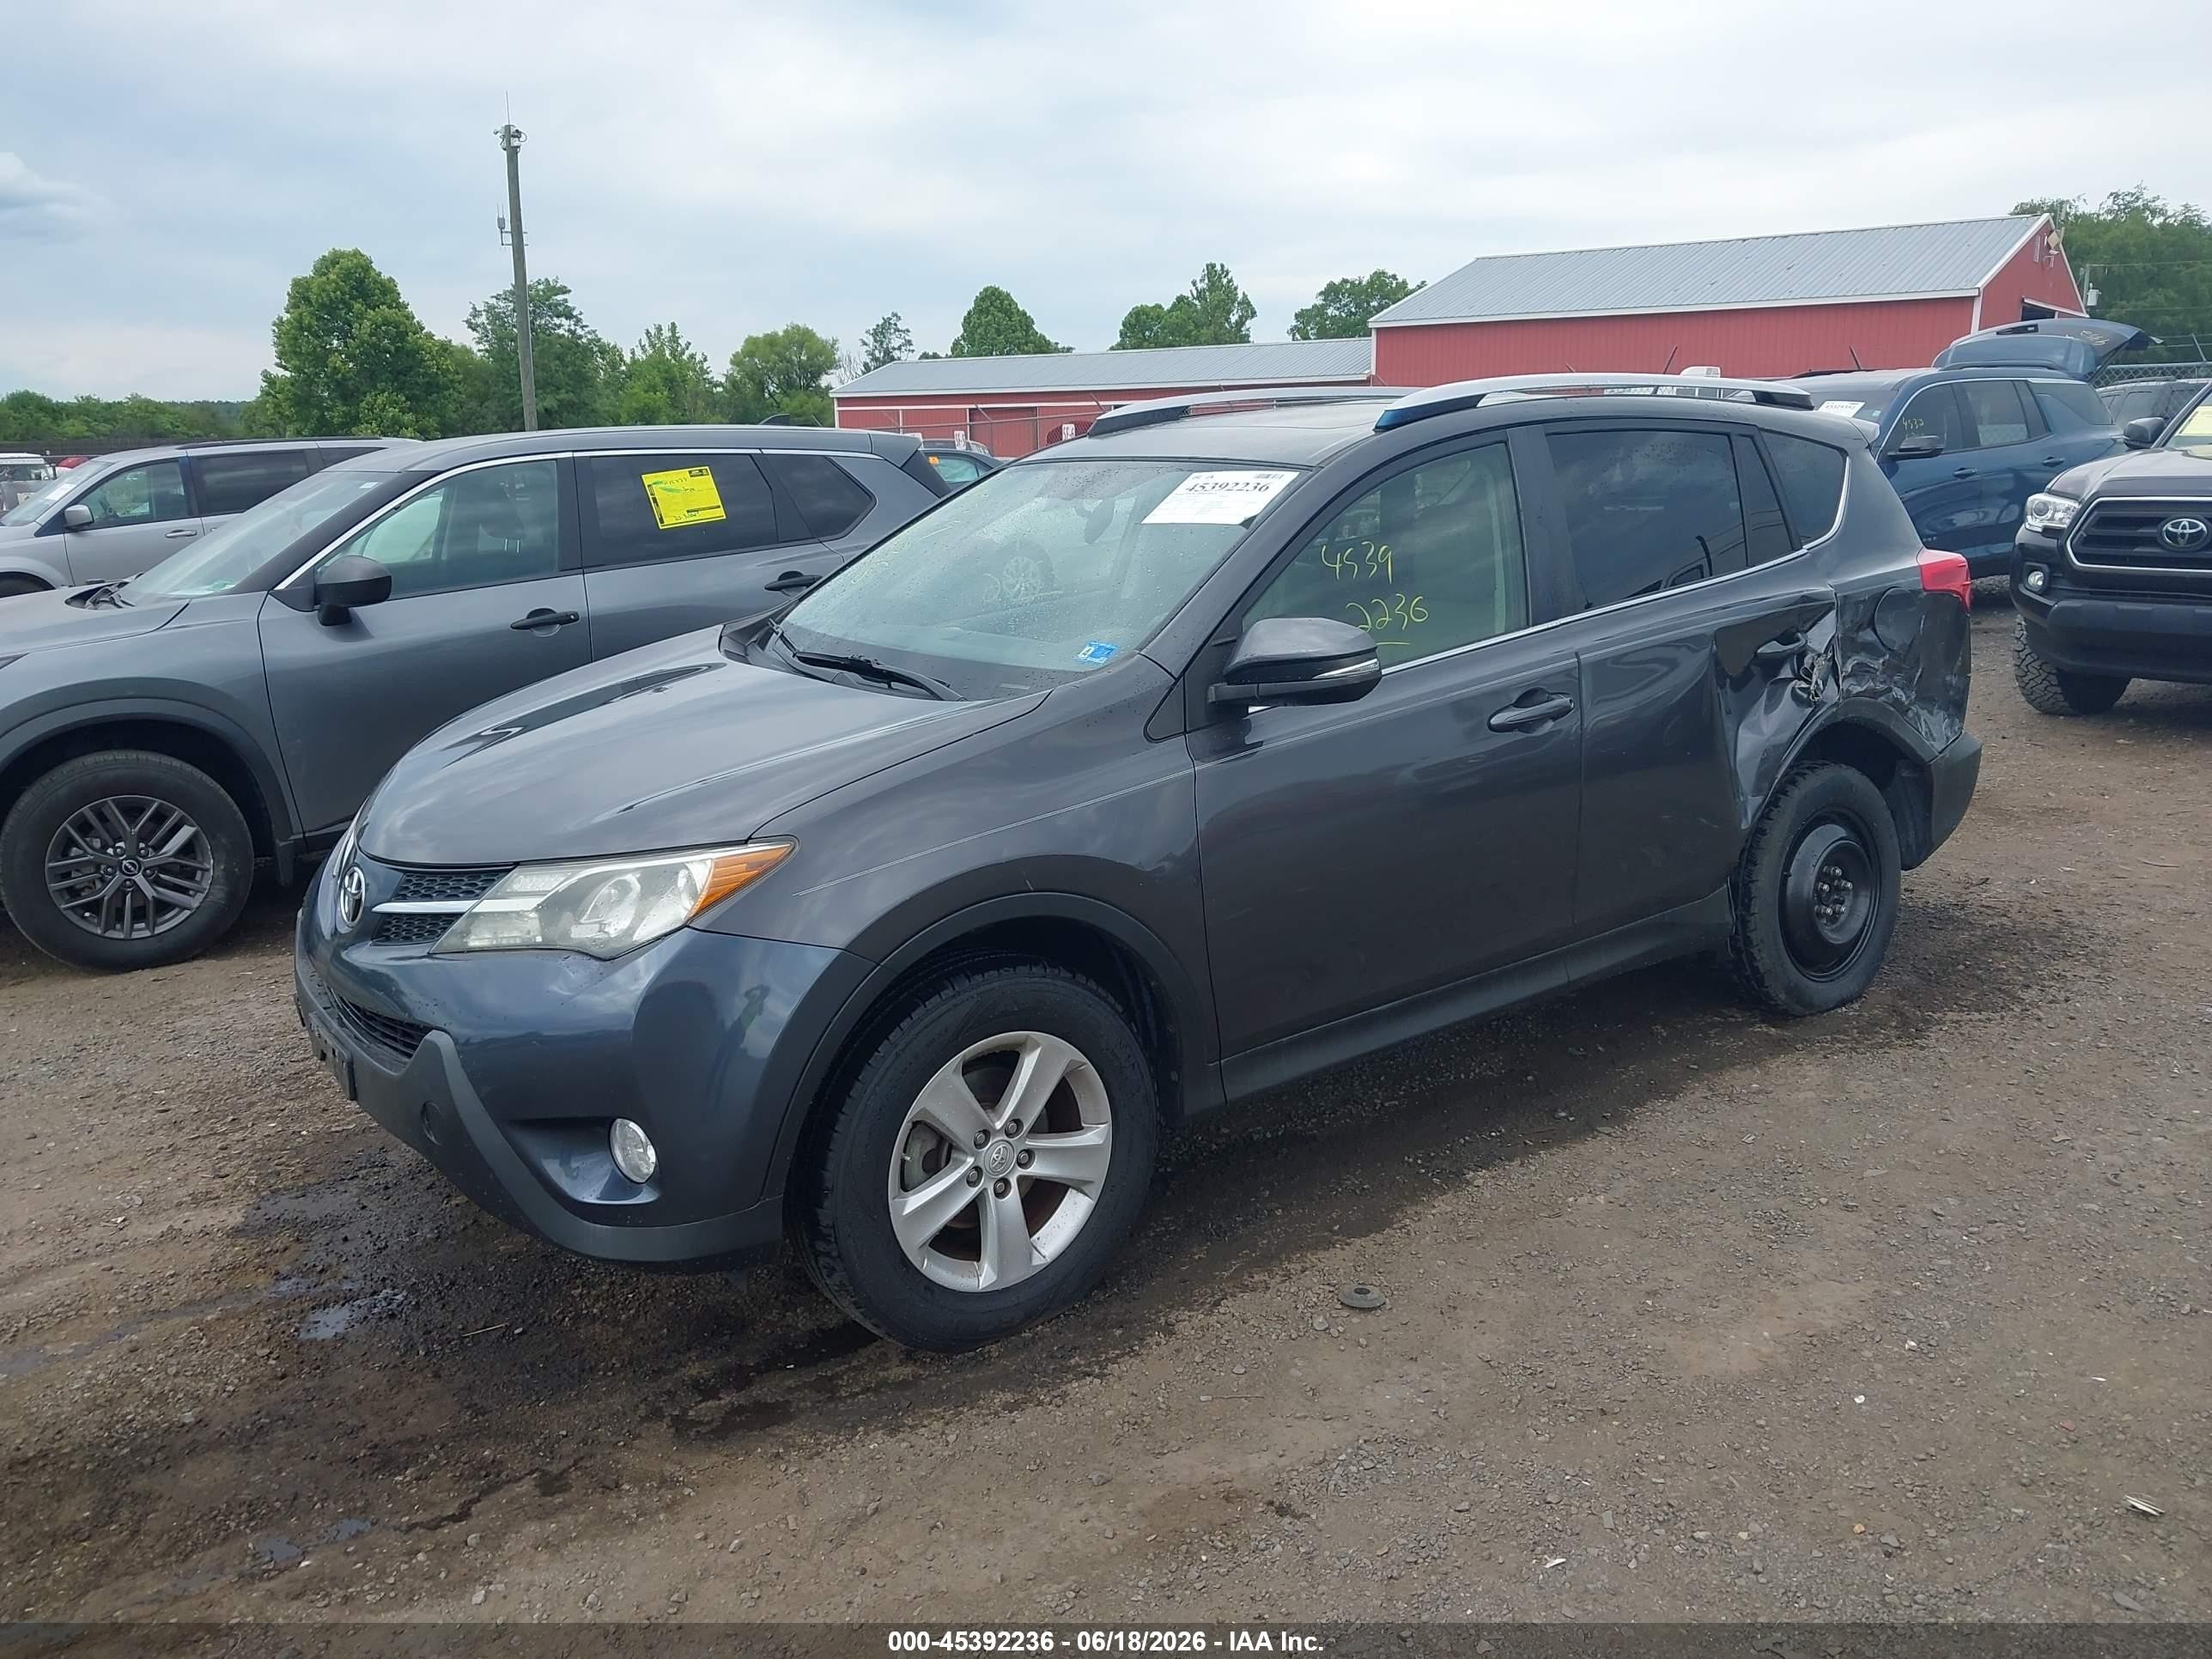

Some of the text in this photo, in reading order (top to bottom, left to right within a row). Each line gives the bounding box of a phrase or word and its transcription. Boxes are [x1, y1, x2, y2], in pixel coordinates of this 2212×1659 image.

[1185, 482, 1270, 493] 45392236
[1321, 541, 1393, 585] 4539
[1345, 593, 1429, 633] 2236
